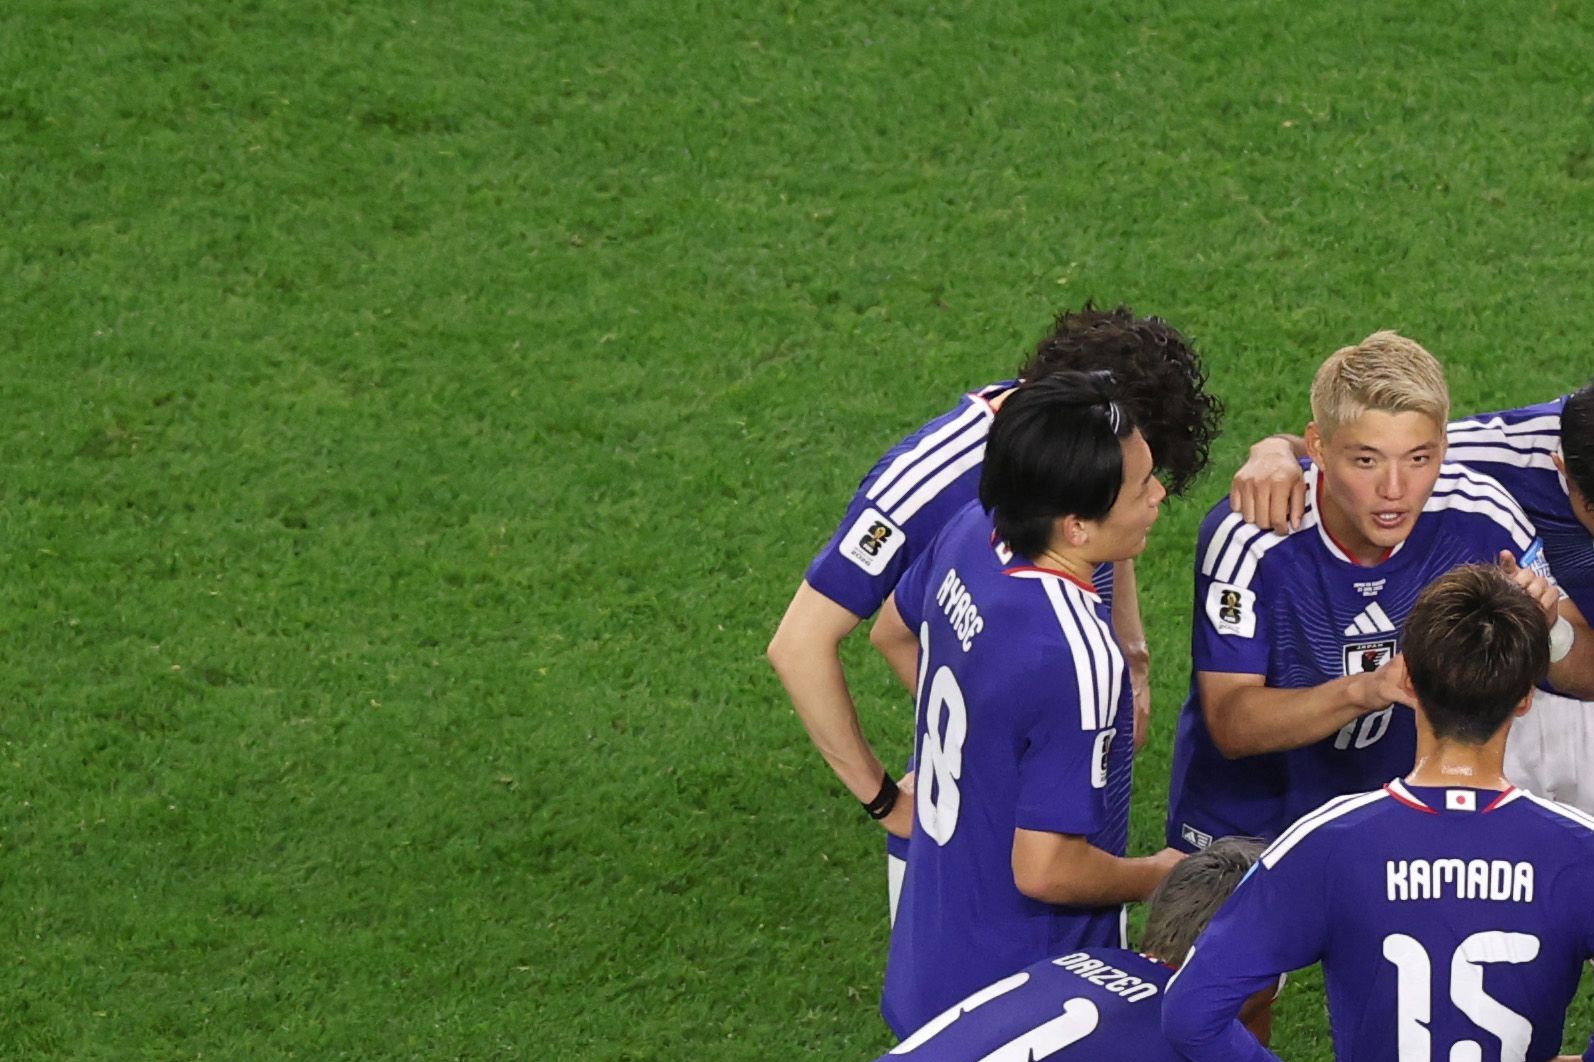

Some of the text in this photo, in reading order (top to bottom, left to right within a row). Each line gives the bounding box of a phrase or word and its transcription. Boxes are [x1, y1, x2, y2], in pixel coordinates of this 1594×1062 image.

[936, 568, 984, 652] AYASE
[1386, 858, 1534, 902] KAMADA
[1051, 952, 1158, 1003] DAIZEN
